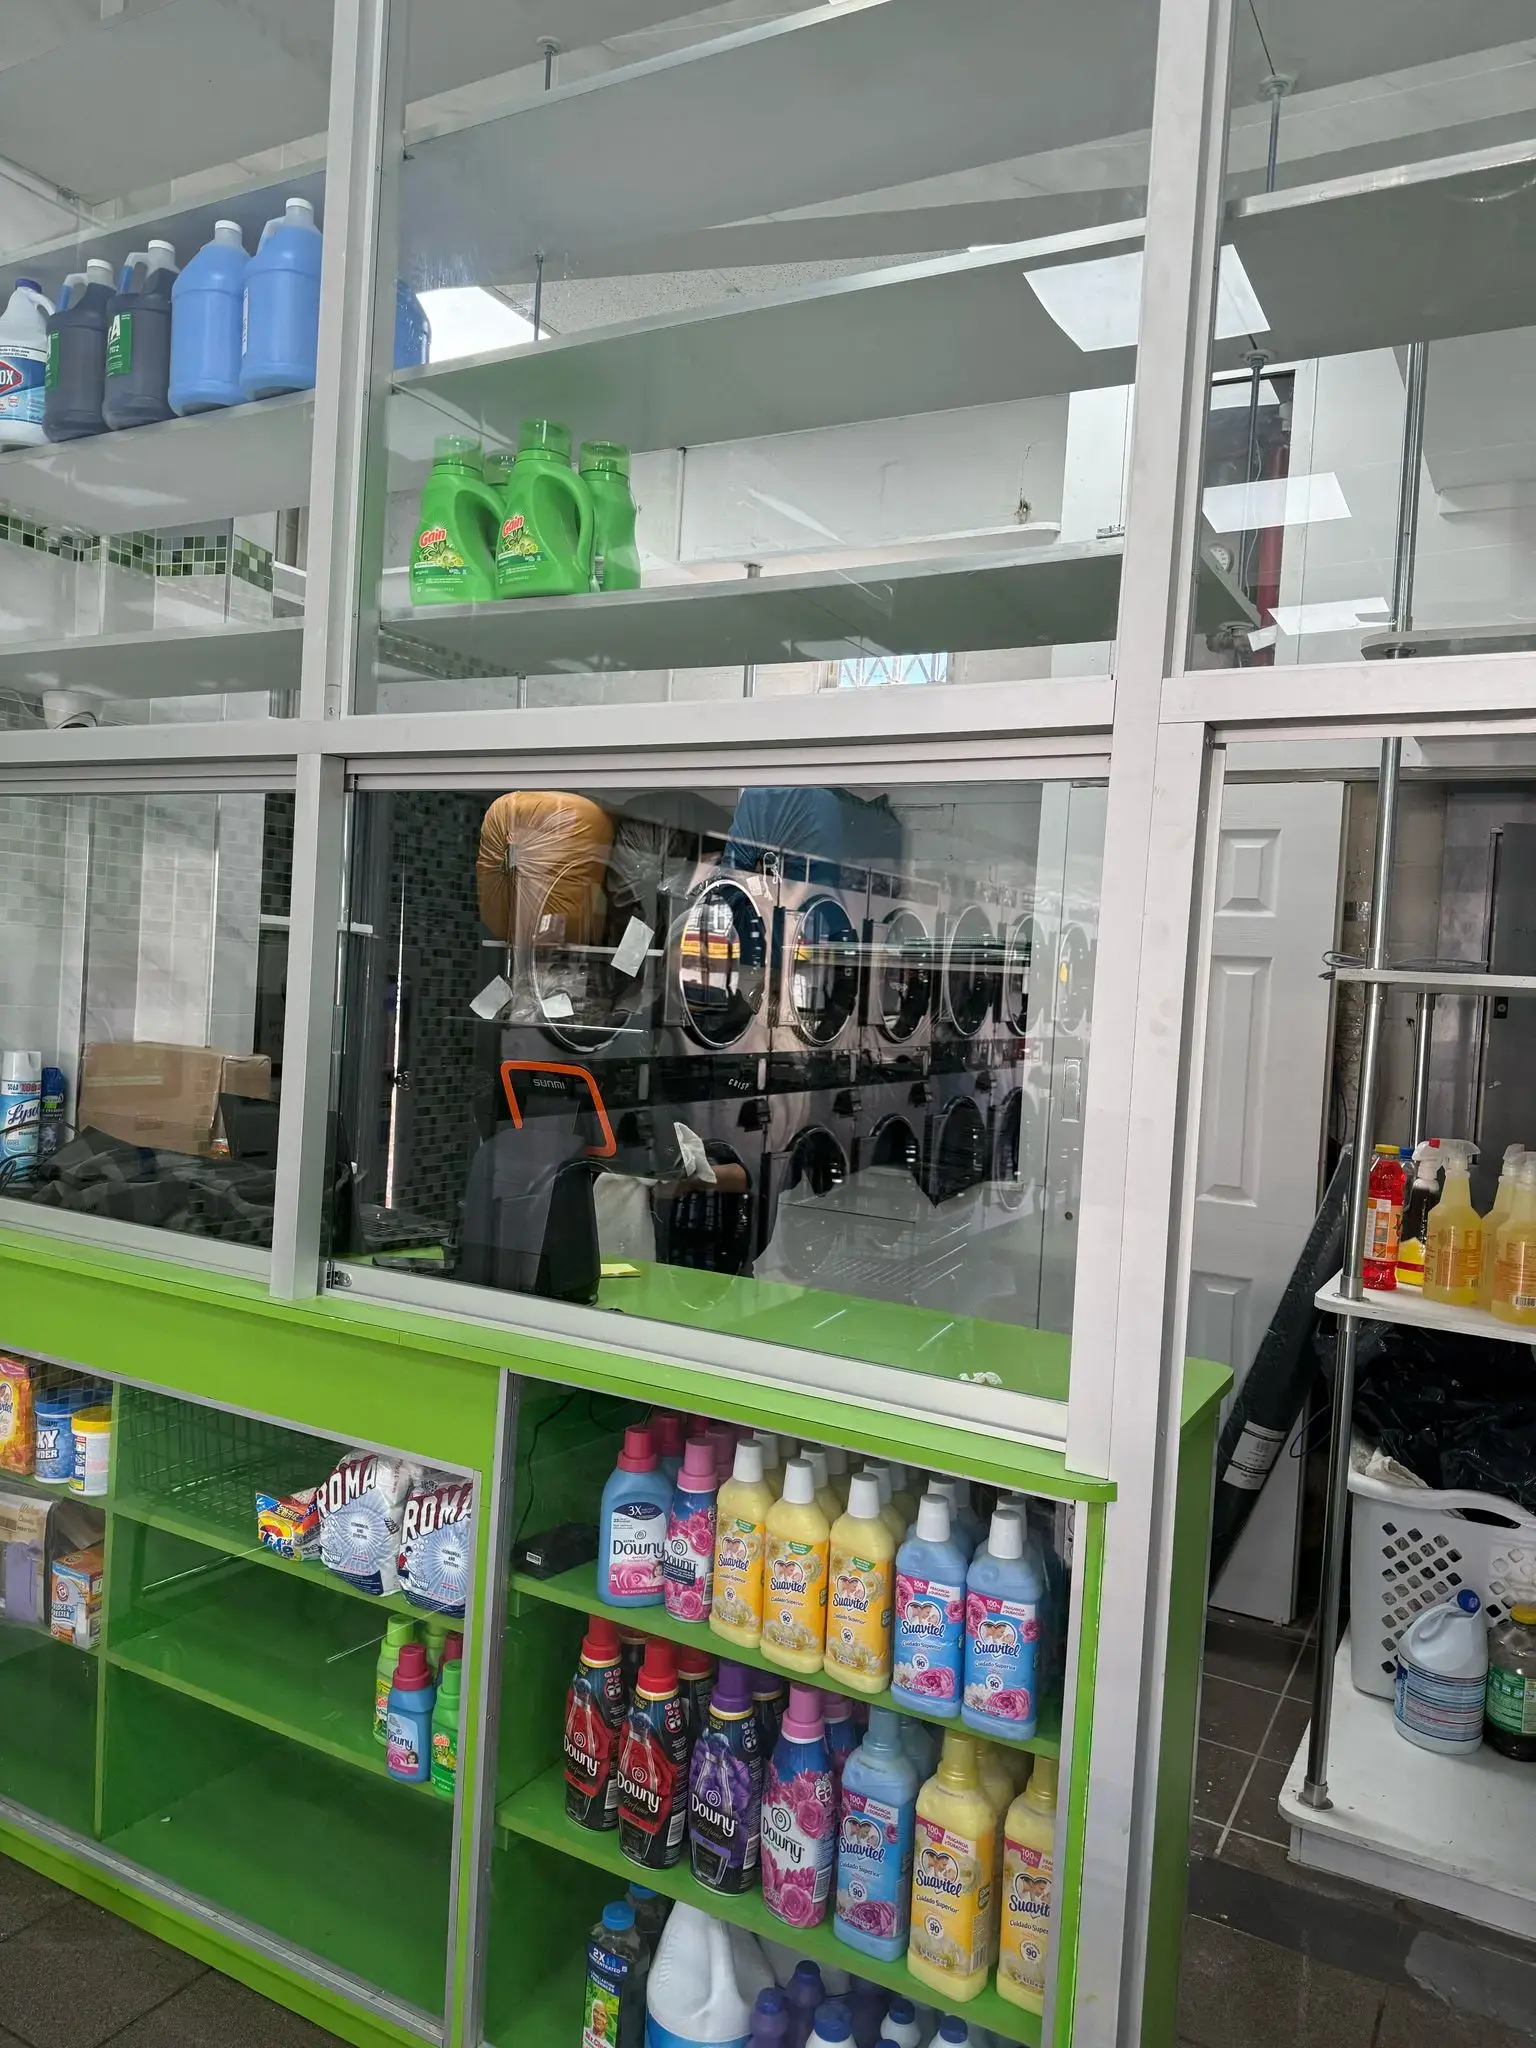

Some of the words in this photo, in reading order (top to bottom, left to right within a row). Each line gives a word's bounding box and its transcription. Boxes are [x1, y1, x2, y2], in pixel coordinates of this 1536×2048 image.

[502, 515, 524, 538] Gain
[420, 529, 446, 548] Gain
[728, 1078, 750, 1091] CRISP
[316, 1455, 378, 1520] ROMA
[628, 1505, 642, 1516] 3X
[613, 1540, 665, 1559] Downy
[718, 1554, 749, 1571] Suavitel
[770, 1578, 806, 1594] Suavitel
[833, 1593, 868, 1612] Suavitel
[901, 1621, 945, 1638] Suavitel
[974, 1641, 1020, 1657] Suavitel
[388, 1730, 413, 1751] Downy
[433, 1734, 450, 1746] Gain
[564, 1734, 598, 1777] Downy
[617, 1770, 660, 1813] Downy
[691, 1793, 736, 1837] Downy
[763, 1816, 802, 1863] Downy
[840, 1838, 885, 1863] Suavitel
[853, 1888, 862, 1897] 90
[916, 1869, 962, 1898] Suavitel
[916, 1894, 935, 1905] Cuidado
[936, 1899, 959, 1914] Superior
[1009, 1894, 1050, 1918] Suavit
[930, 1922, 940, 1934] 90
[1009, 1920, 1031, 1930] Cuidado
[1032, 1924, 1049, 1935] Super
[593, 1947, 606, 1963] 2X
[1026, 1948, 1037, 1958] 90
